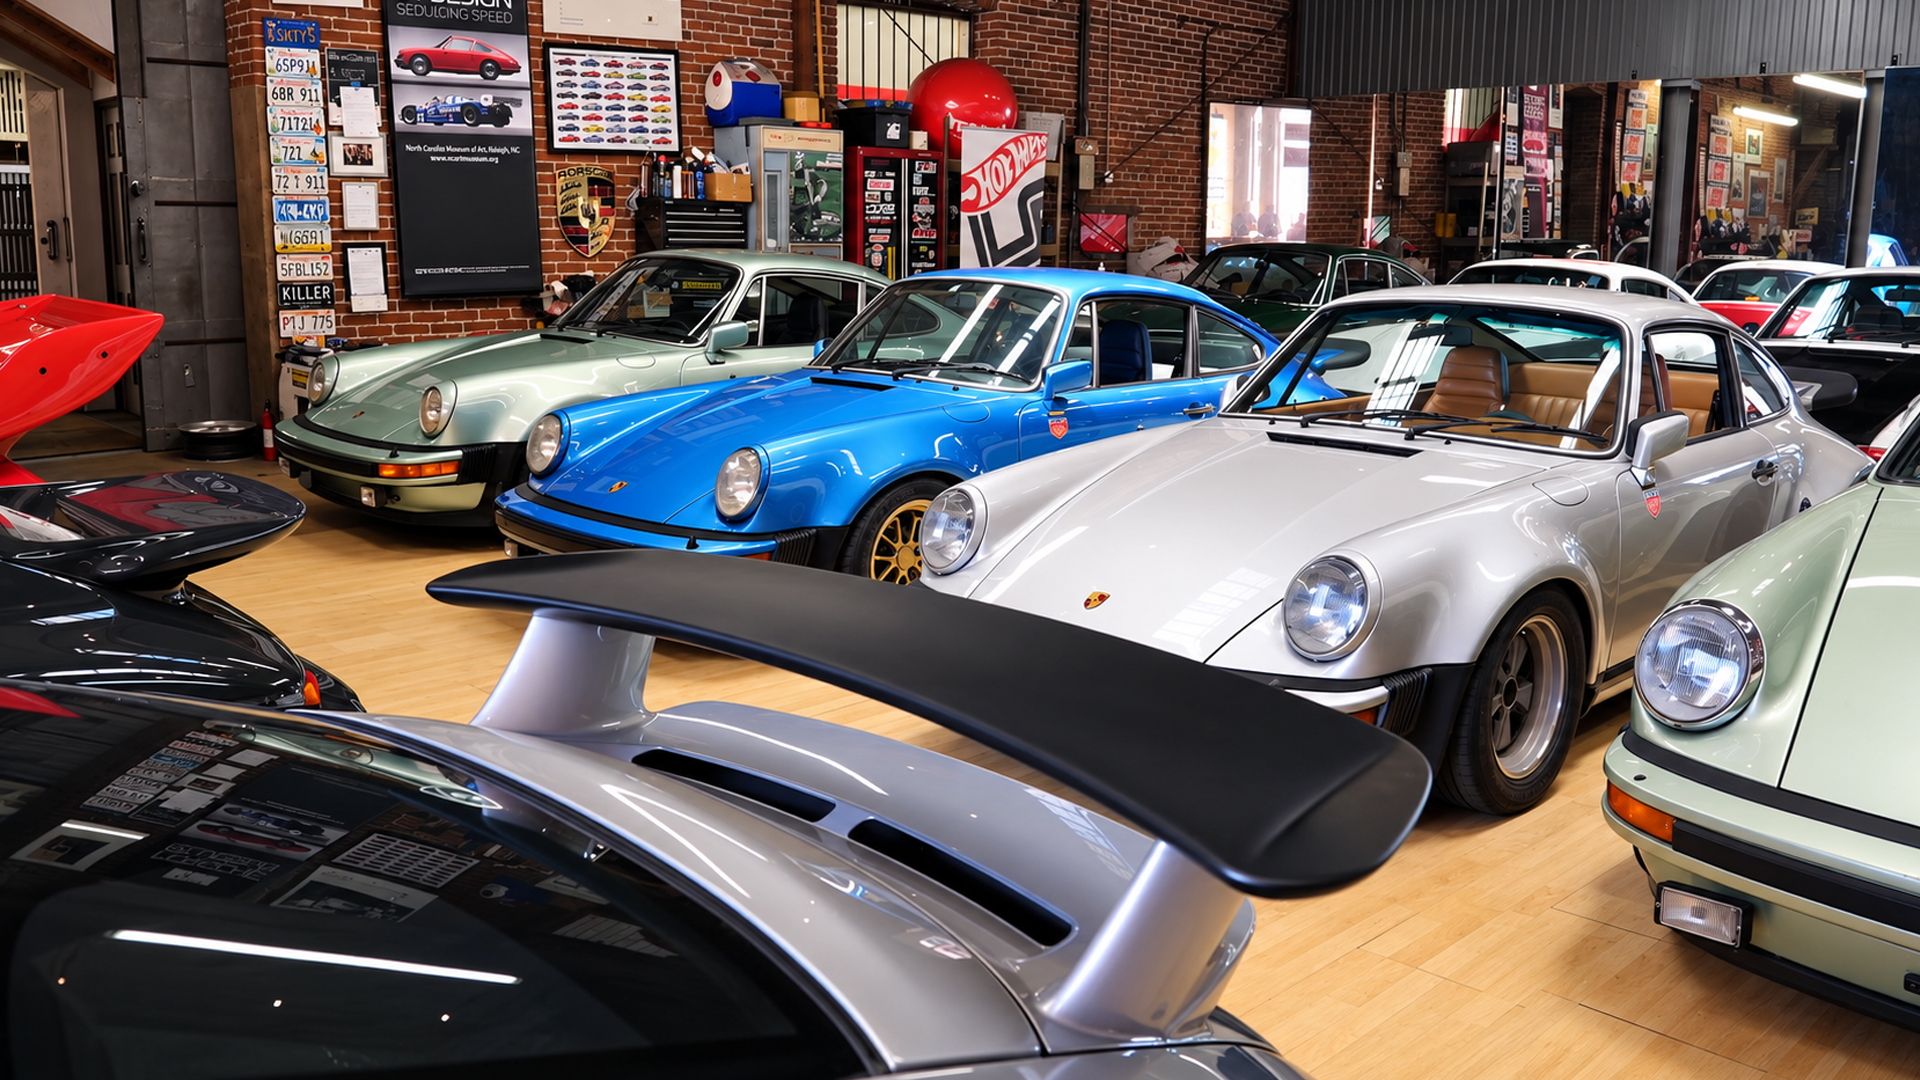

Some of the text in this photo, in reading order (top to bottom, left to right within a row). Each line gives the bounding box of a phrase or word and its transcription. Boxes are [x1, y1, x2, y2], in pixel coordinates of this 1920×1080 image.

[471, 9, 513, 24] SPEED
[271, 86, 320, 102] 68R 911
[275, 174, 289, 189] 72
[305, 175, 325, 189] 911
[282, 285, 331, 301] KILLER
